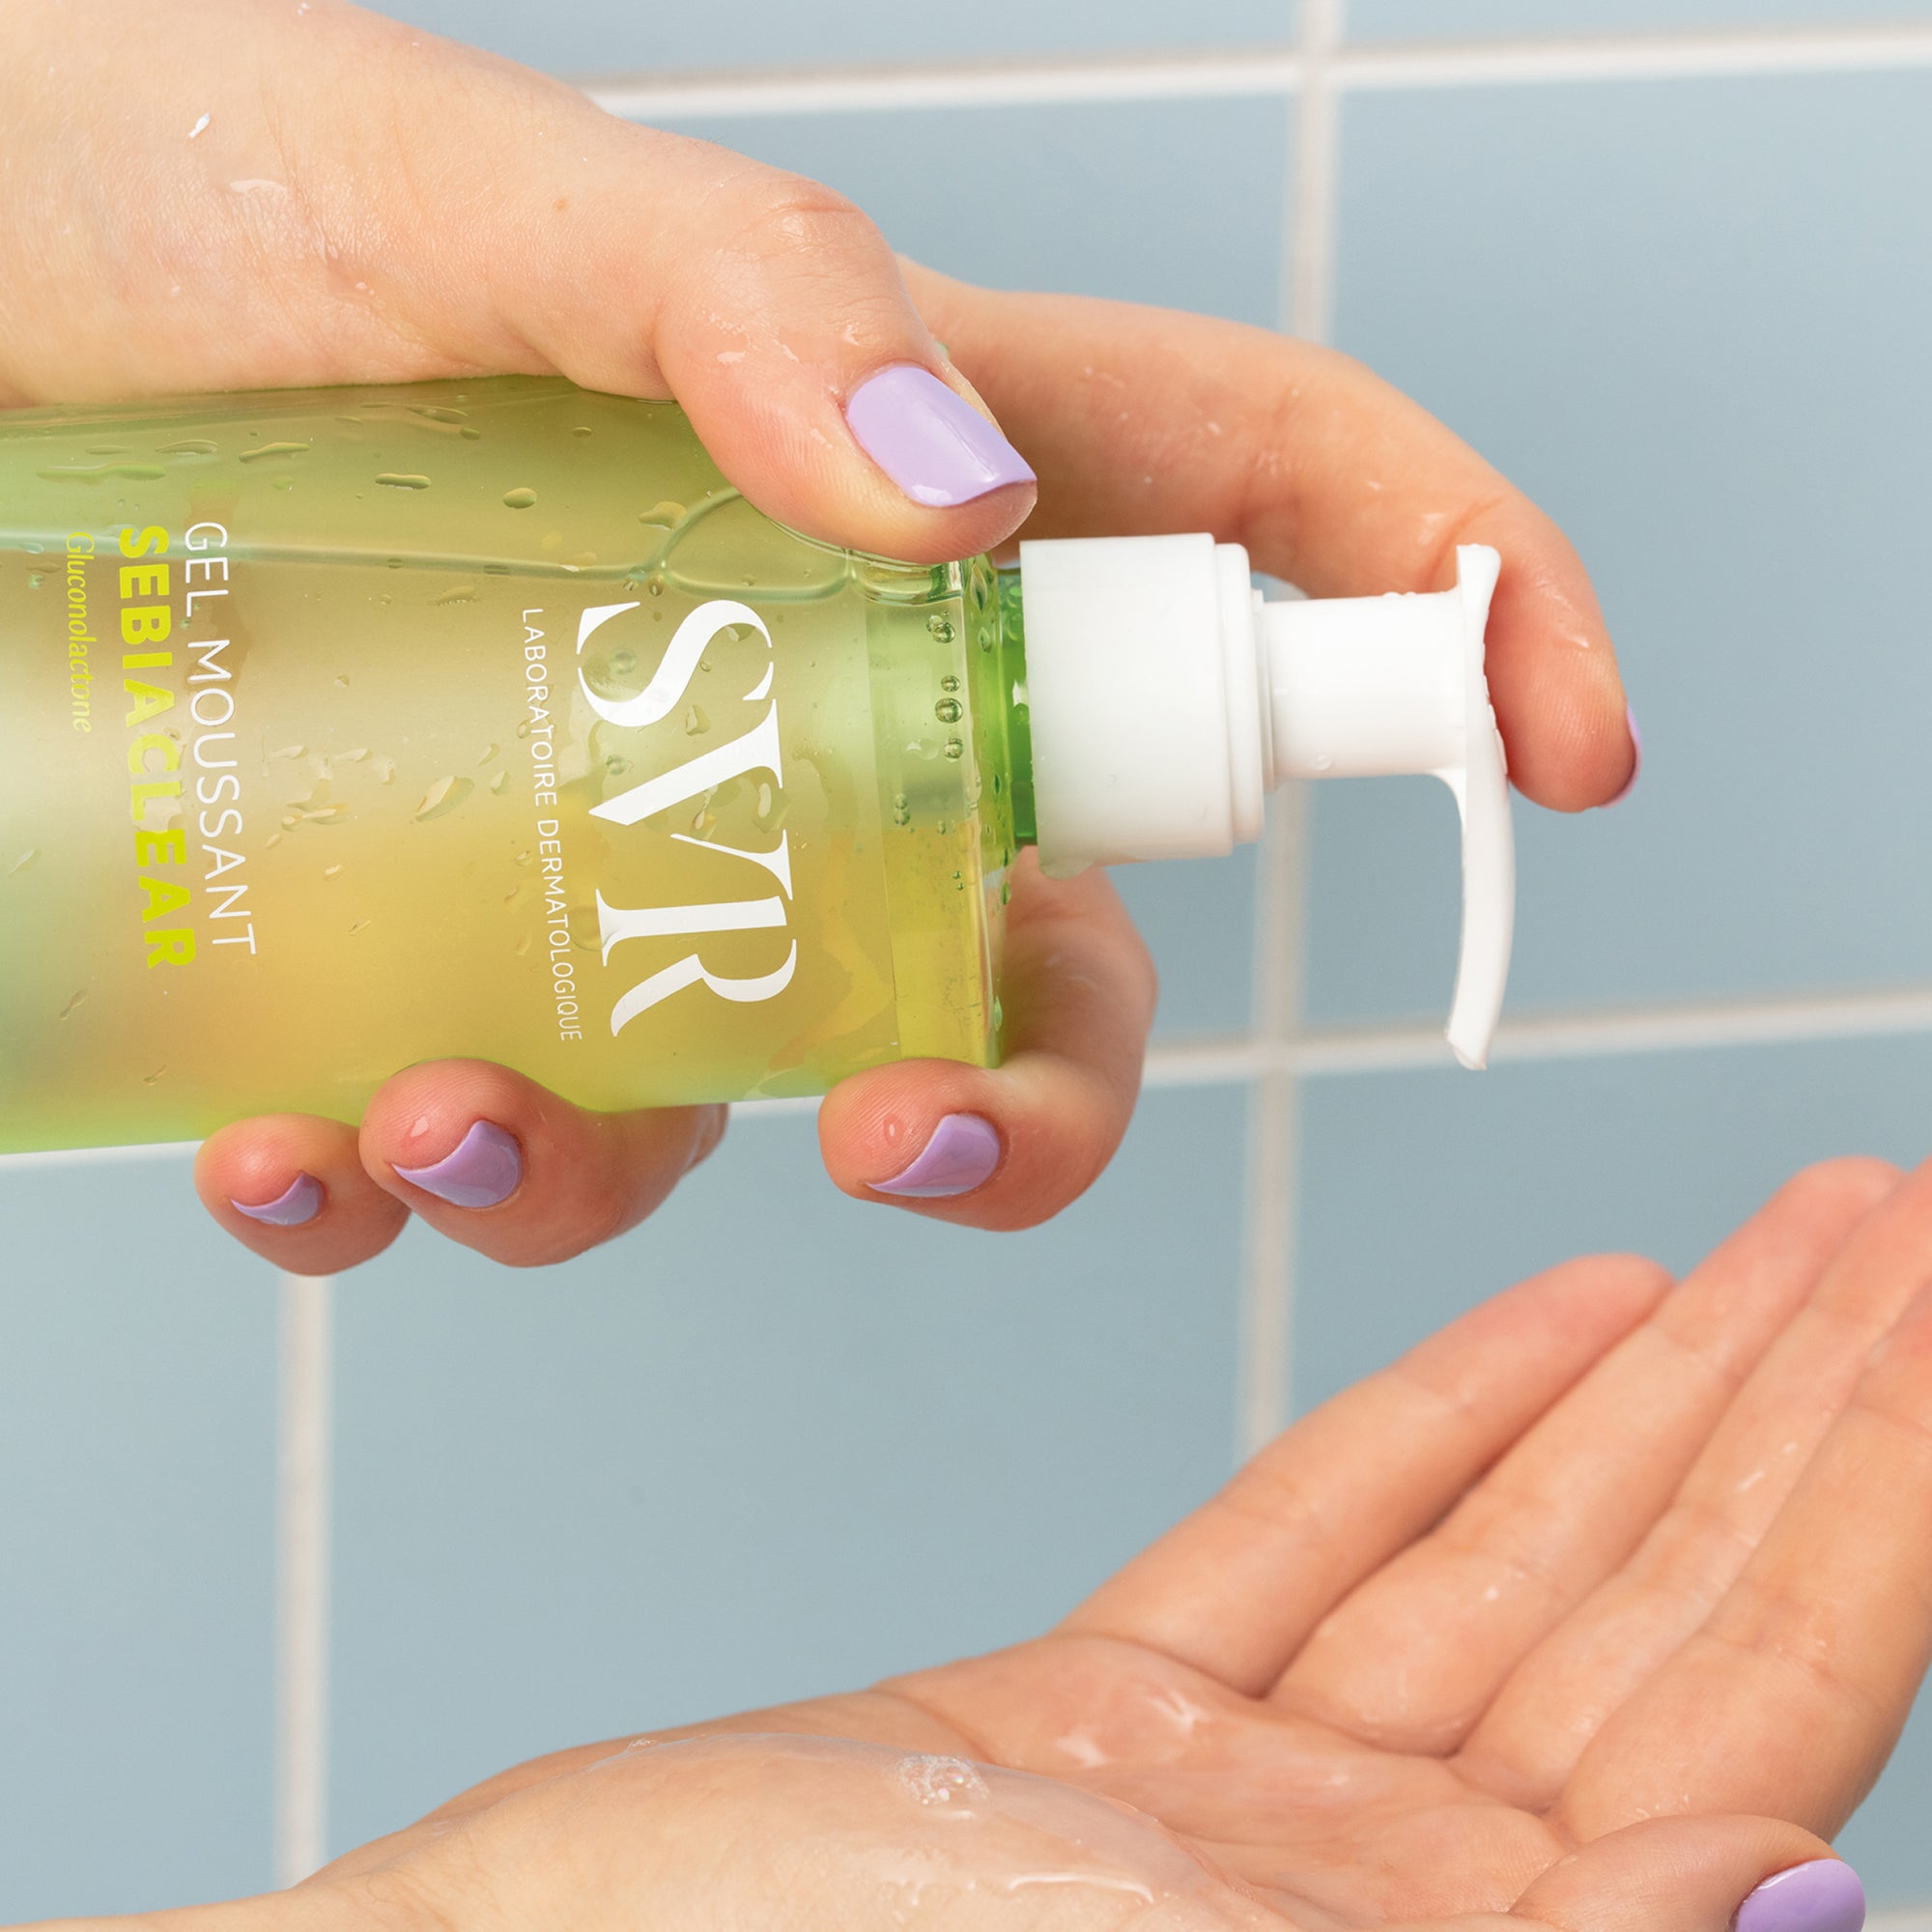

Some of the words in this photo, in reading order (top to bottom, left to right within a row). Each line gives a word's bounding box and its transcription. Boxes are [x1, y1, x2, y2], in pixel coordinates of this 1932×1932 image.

[66, 531, 98, 732] Gluconolactone
[185, 522, 229, 617] GEL
[118, 526, 196, 969] SEBIACLEAR
[186, 639, 256, 954] MOUSSANT
[522, 609, 557, 807] LABORATOIRE
[576, 599, 796, 1037] SVR
[537, 819, 582, 1041] DERMATOLOGIQUE
